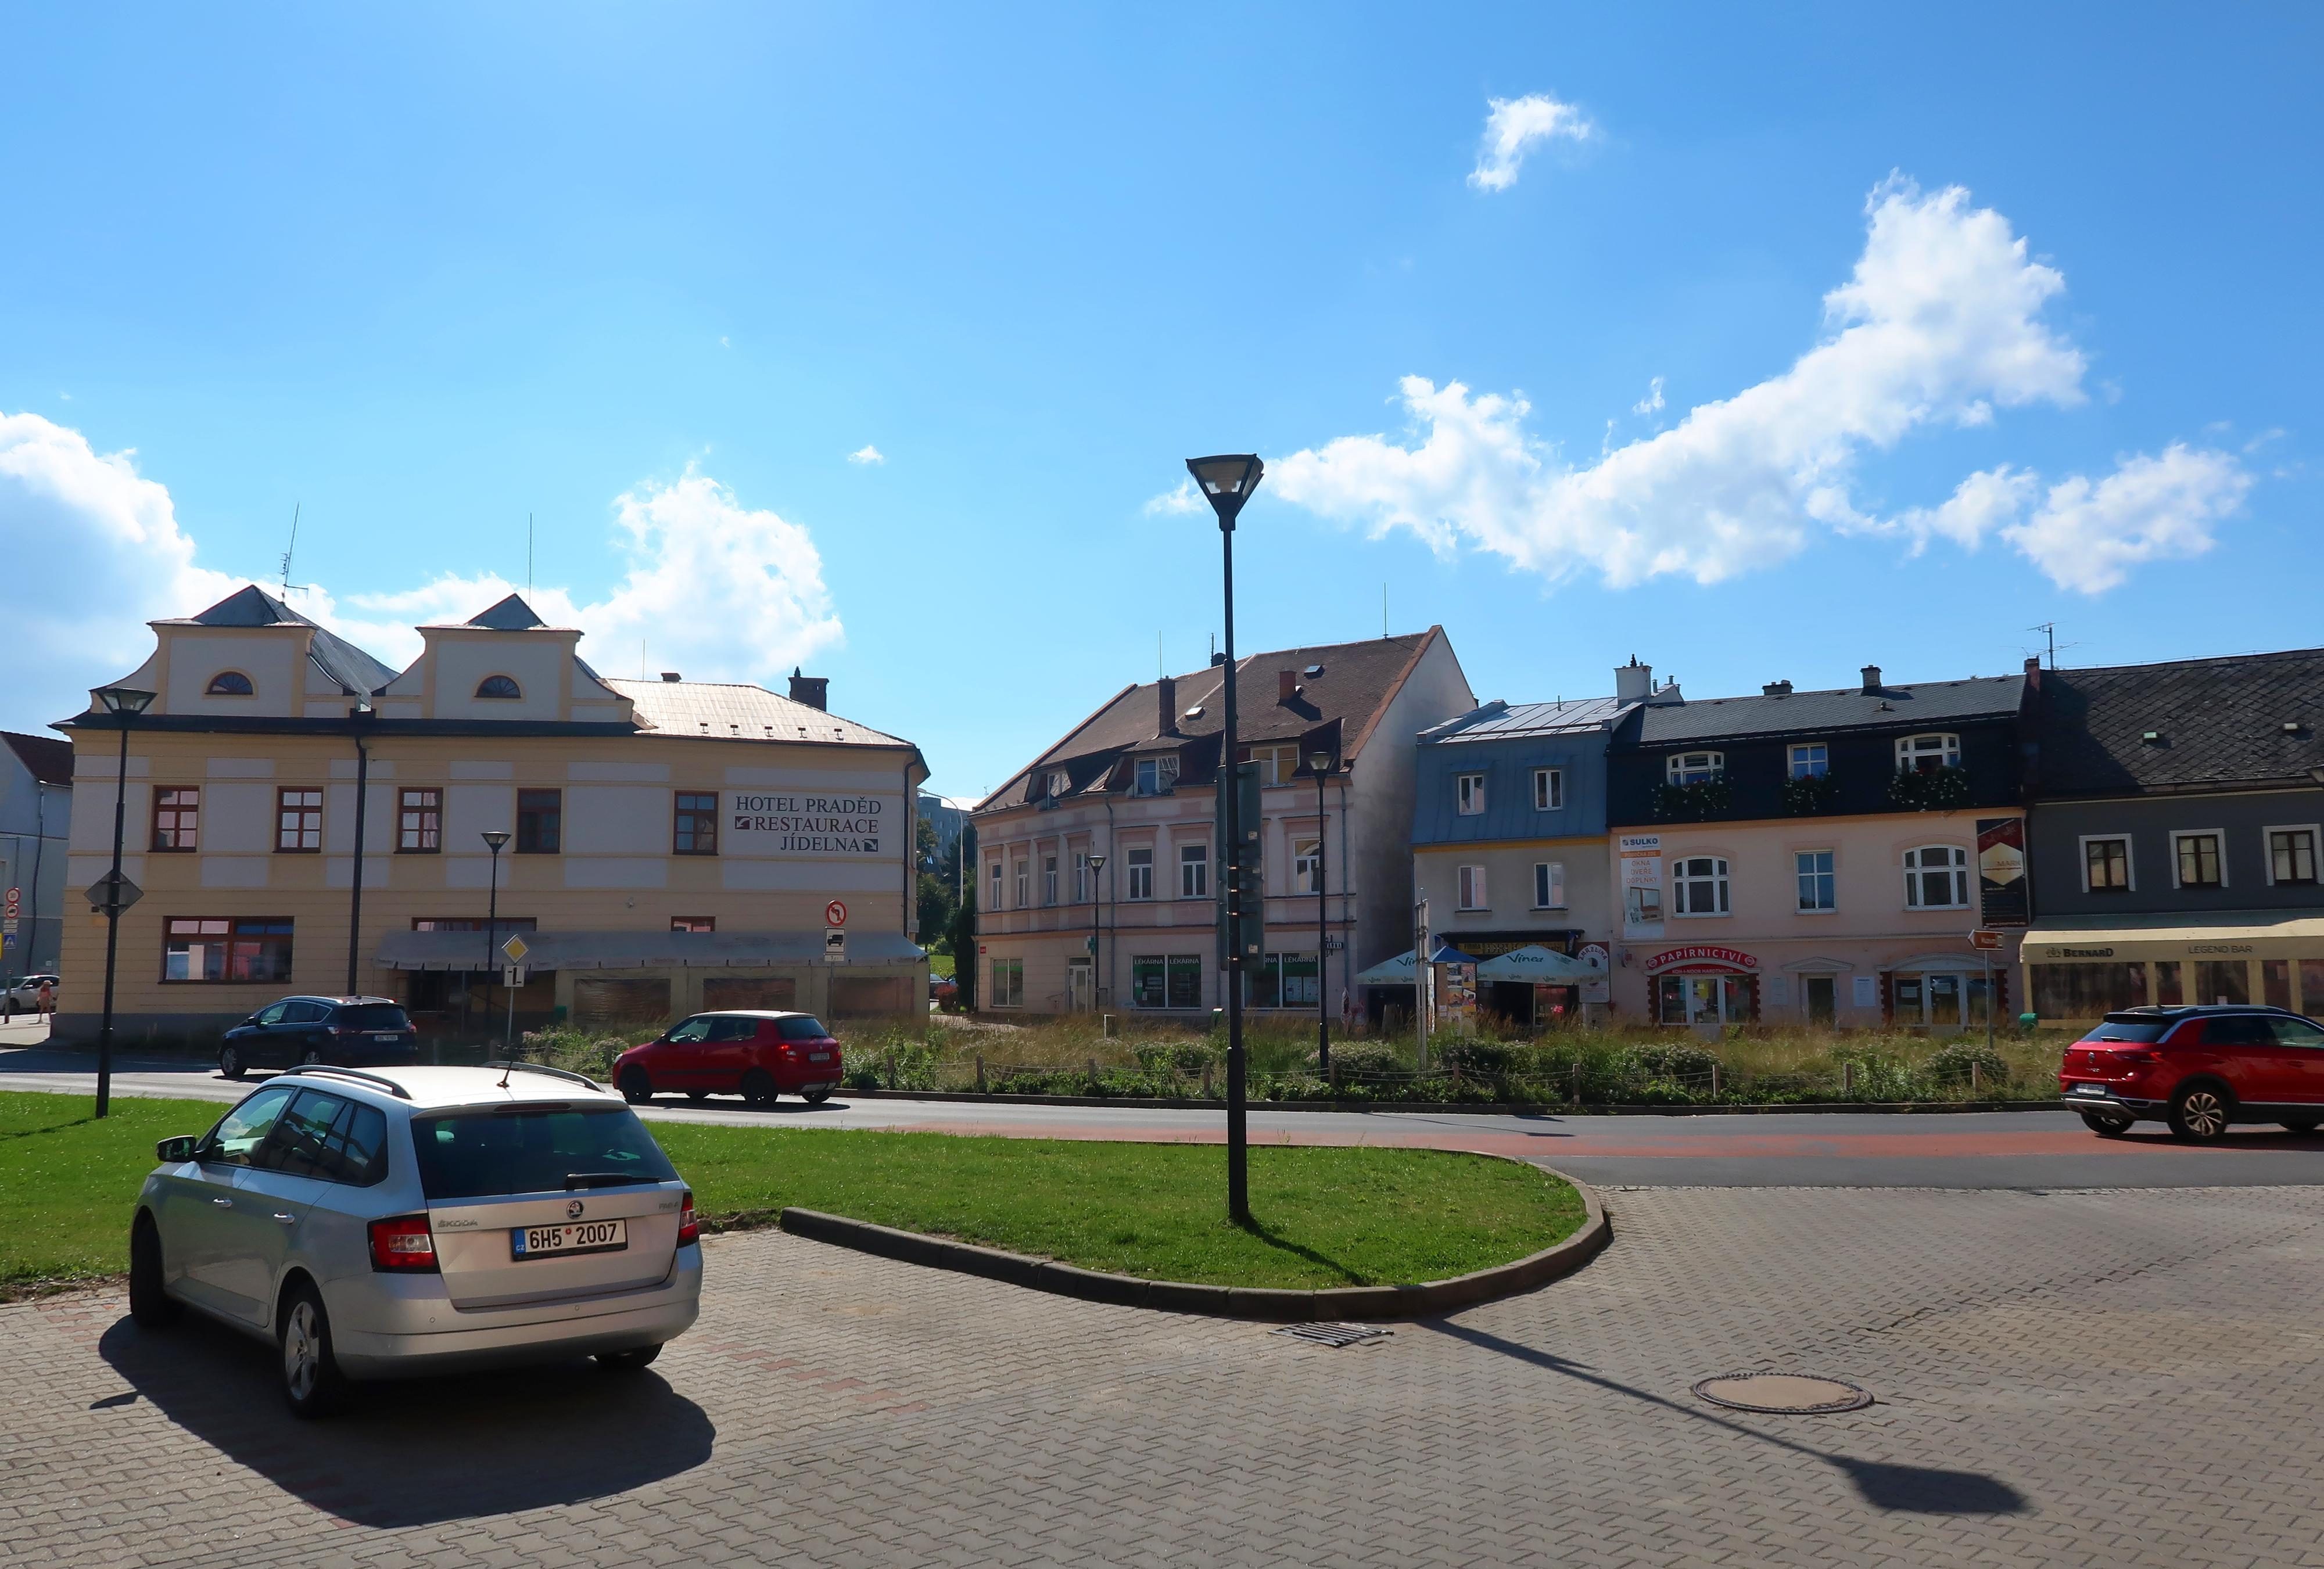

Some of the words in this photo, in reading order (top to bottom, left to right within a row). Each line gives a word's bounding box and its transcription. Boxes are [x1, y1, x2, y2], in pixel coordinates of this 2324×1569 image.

[736, 796, 799, 812] HOTEL
[805, 796, 881, 814] PRADĚD
[754, 816, 879, 833] RESTAURACE
[780, 832, 861, 852] JÍDELNA
[1579, 947, 1607, 960] ZMRZLINA
[1660, 947, 1742, 963] PAPÍRNICTVÍ
[2063, 948, 2114, 957] BERNARD
[2188, 945, 2228, 953] LEGEND
[2230, 945, 2253, 953] BAR
[1507, 953, 1543, 963] Vinea
[437, 1219, 478, 1228] ŠKODA
[529, 1228, 562, 1249] 6H5
[576, 1223, 617, 1245] 2007
